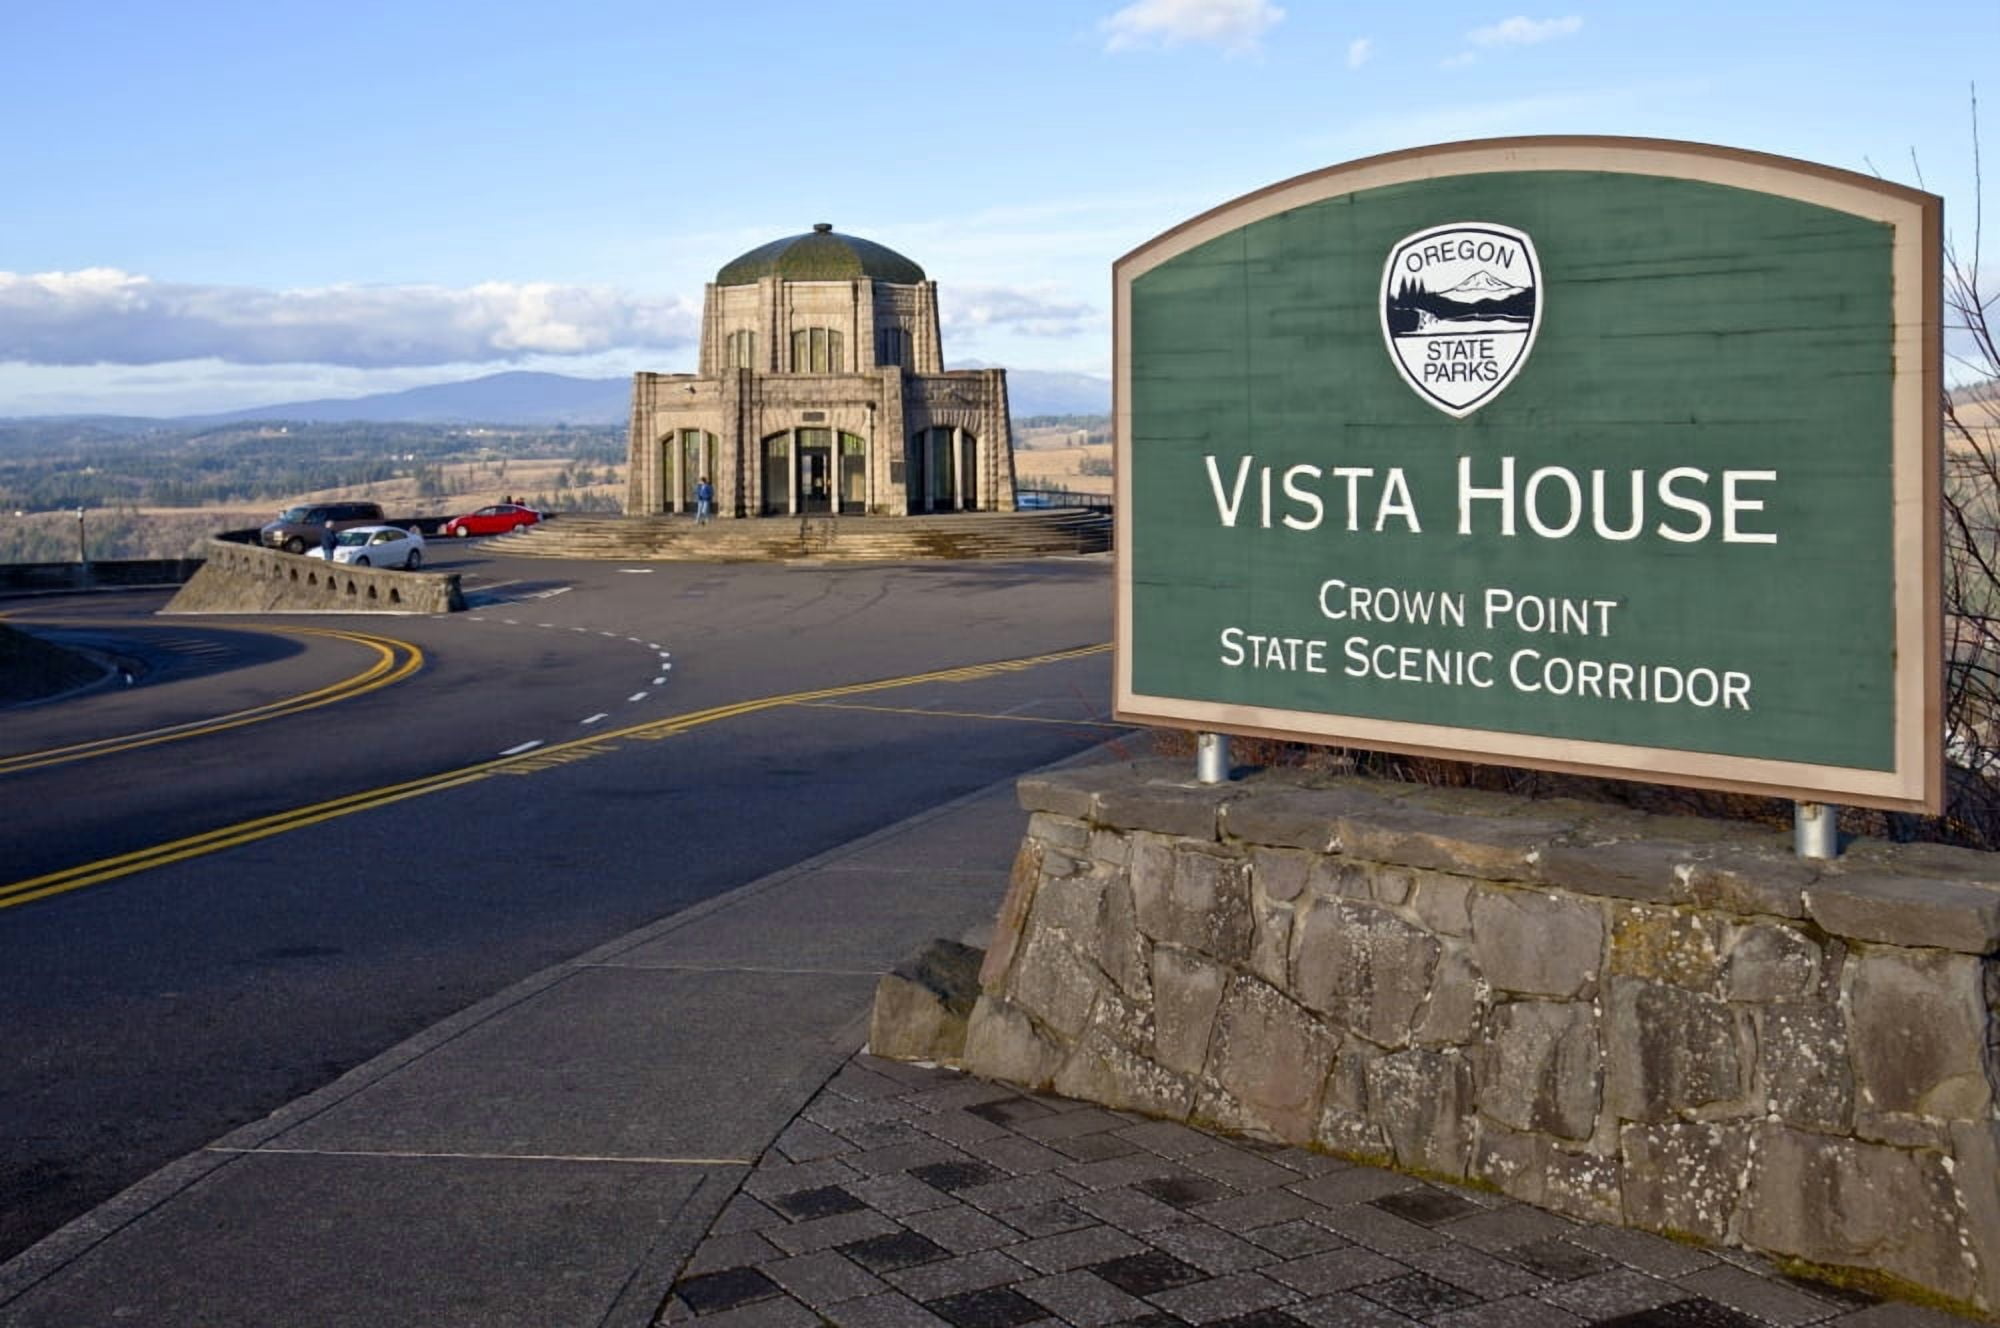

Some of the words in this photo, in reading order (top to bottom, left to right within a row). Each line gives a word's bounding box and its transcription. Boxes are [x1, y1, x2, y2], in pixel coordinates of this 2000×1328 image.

[1406, 240, 1514, 272] OREGON
[1424, 359, 1498, 382] PARKS
[1427, 338, 1494, 360] STATE
[1205, 455, 1421, 533] VISTA
[1458, 456, 1777, 544] HOUSE
[1318, 579, 1464, 627] CROWN
[1484, 588, 1617, 636] POINT
[1220, 627, 1327, 674] STATE
[1344, 636, 1493, 688] SCENIC
[1509, 648, 1751, 711] CORRIDOR
